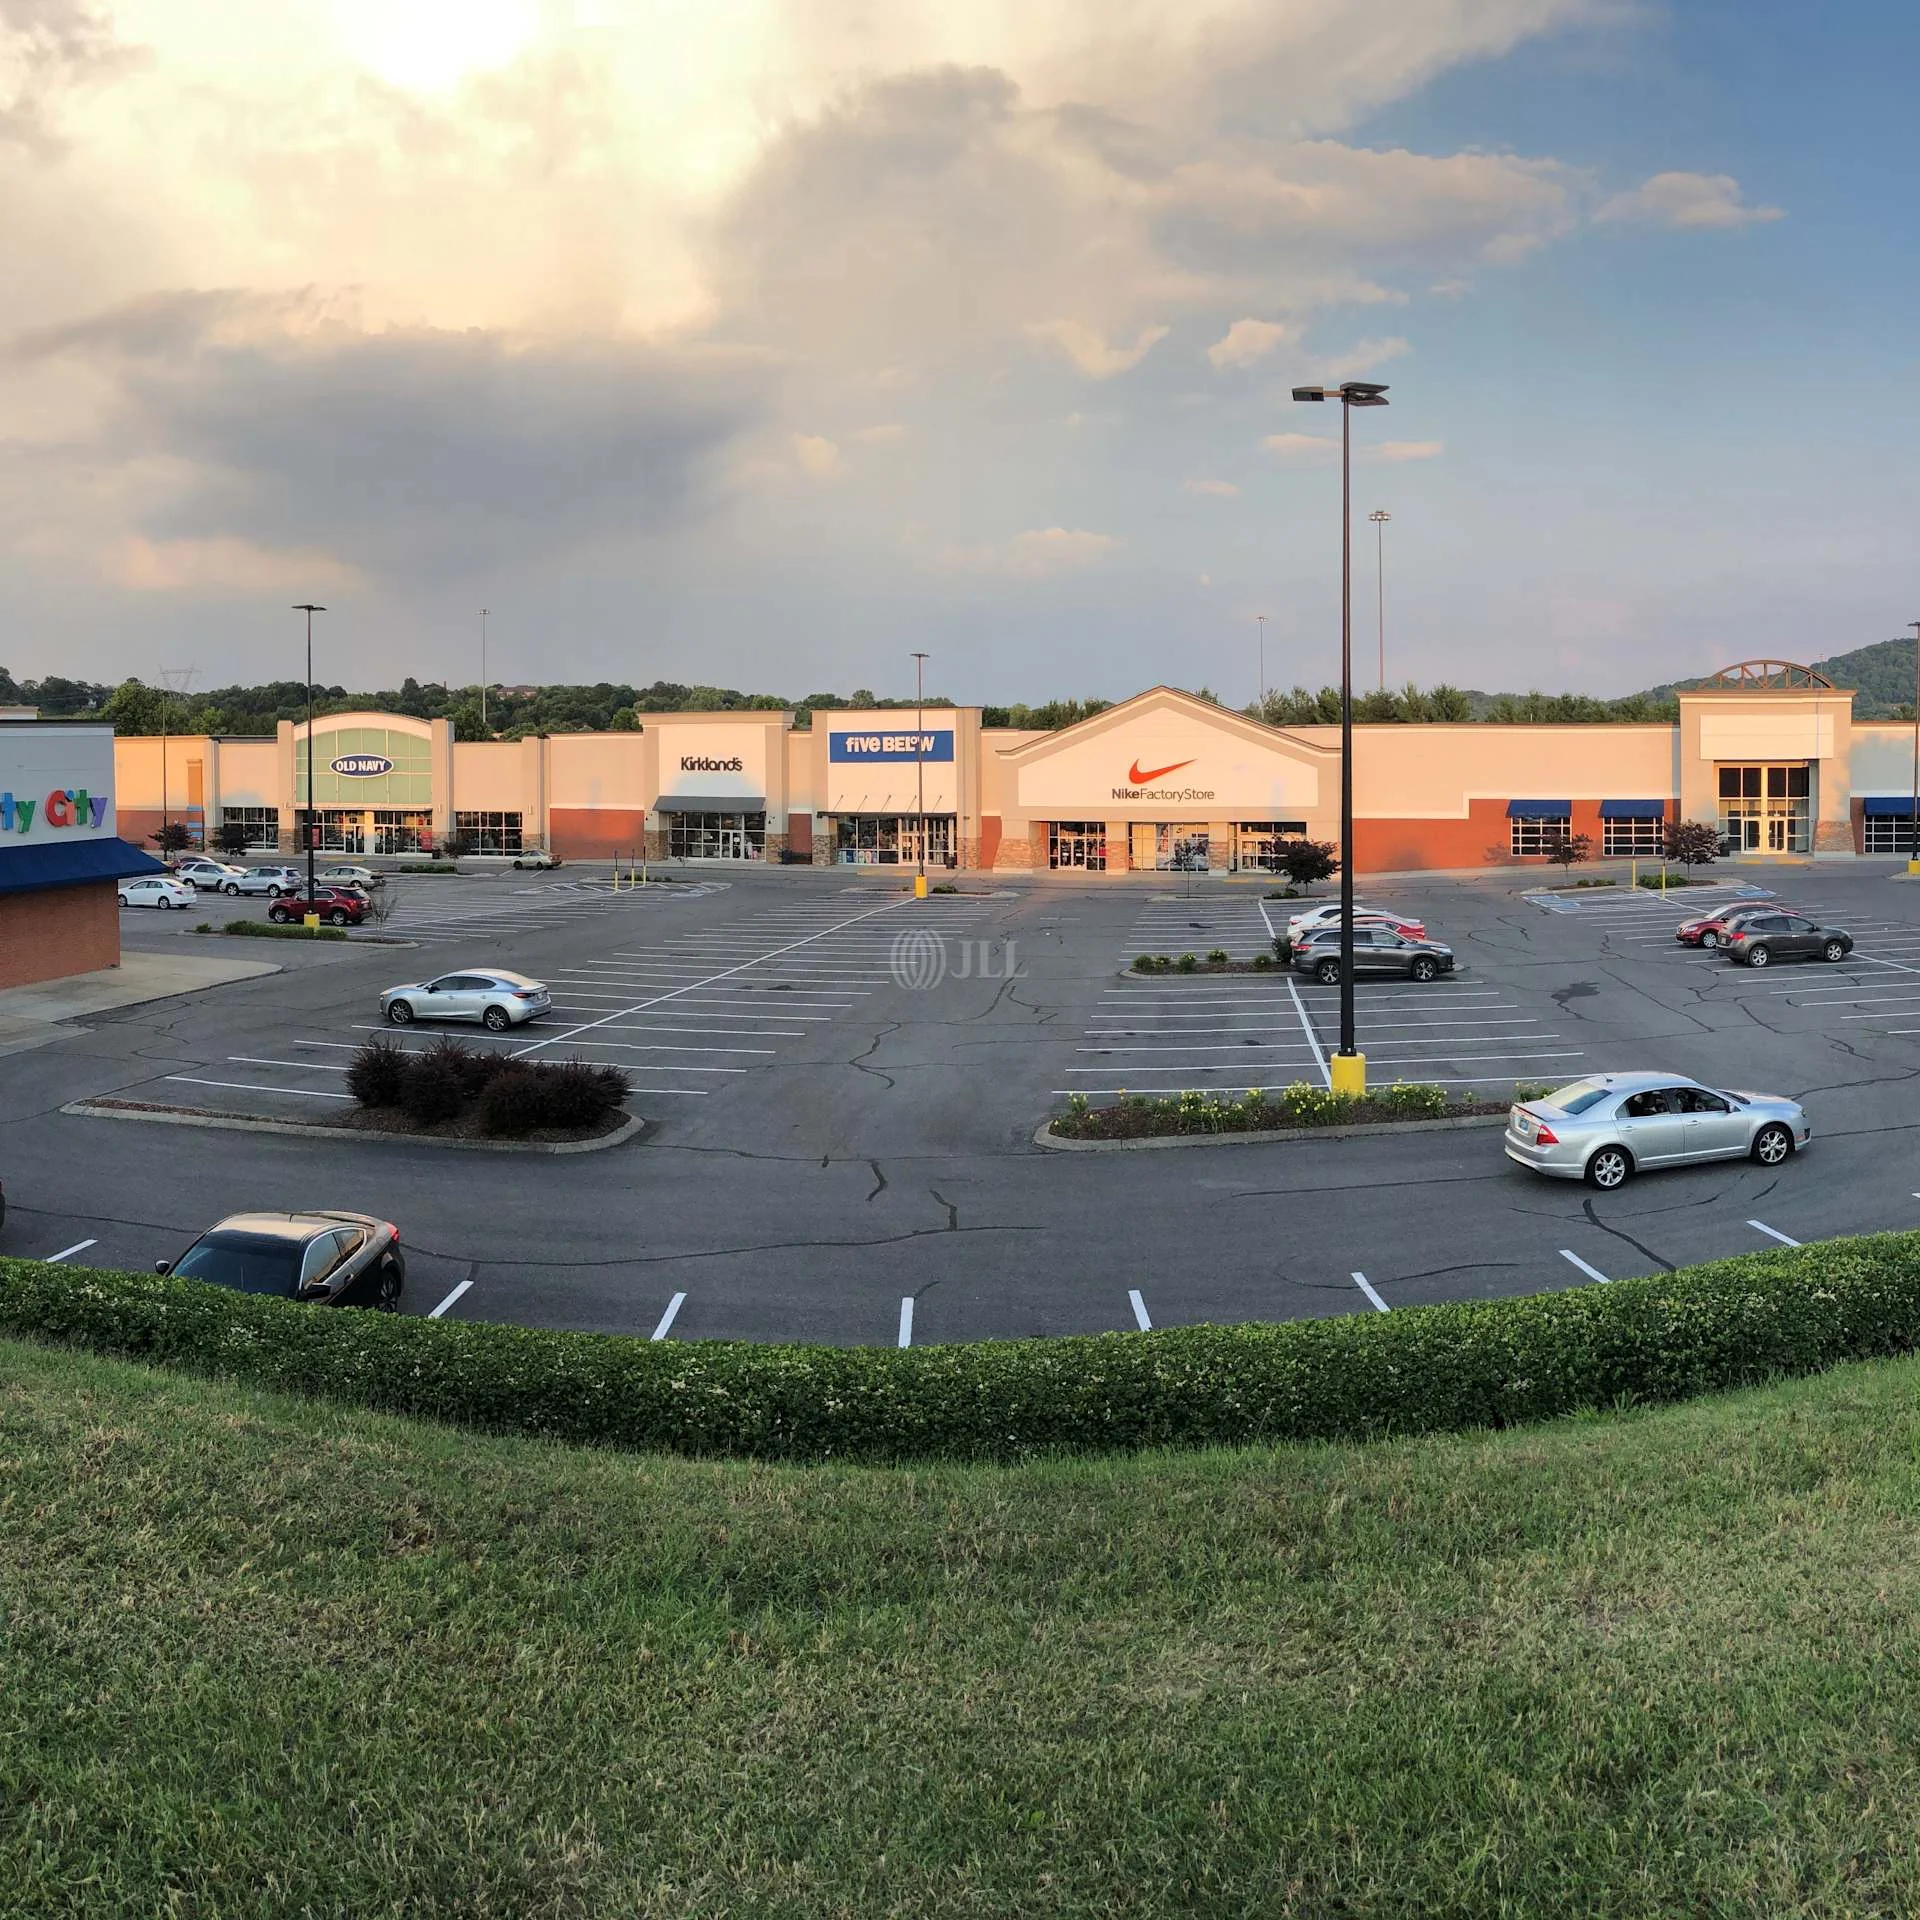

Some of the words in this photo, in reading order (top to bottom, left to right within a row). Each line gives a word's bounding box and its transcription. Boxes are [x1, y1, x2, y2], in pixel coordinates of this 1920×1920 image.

[882, 735, 935, 752] BELOW
[336, 760, 357, 772] OLD
[358, 760, 386, 772] NAVY
[680, 756, 743, 772] Kirkland's
[44, 788, 108, 828] City
